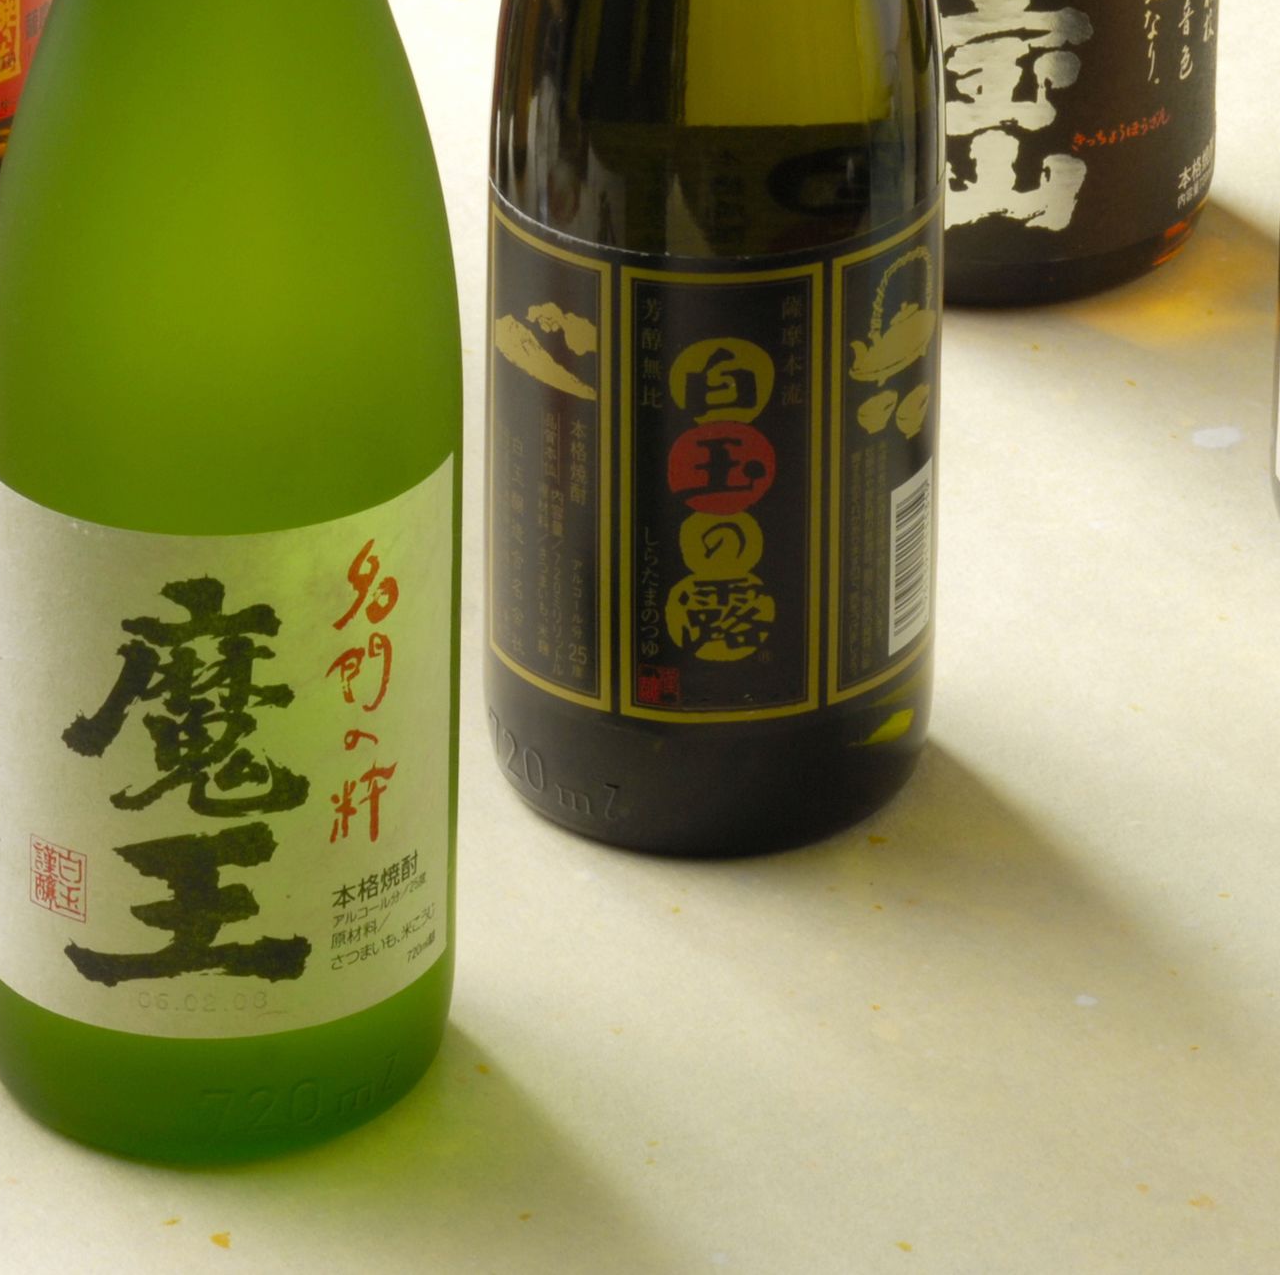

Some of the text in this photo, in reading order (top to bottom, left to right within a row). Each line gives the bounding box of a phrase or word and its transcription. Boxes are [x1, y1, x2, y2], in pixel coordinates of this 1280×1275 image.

[640, 298, 664, 409] 芳醇無比
[569, 419, 587, 506] 本格焼酎
[666, 338, 776, 661] 白玉の露
[640, 526, 660, 657] しらたまのつゆ
[324, 538, 401, 844] 名門の粋
[61, 576, 313, 988] 魔王
[331, 848, 419, 910] 本格焼酎
